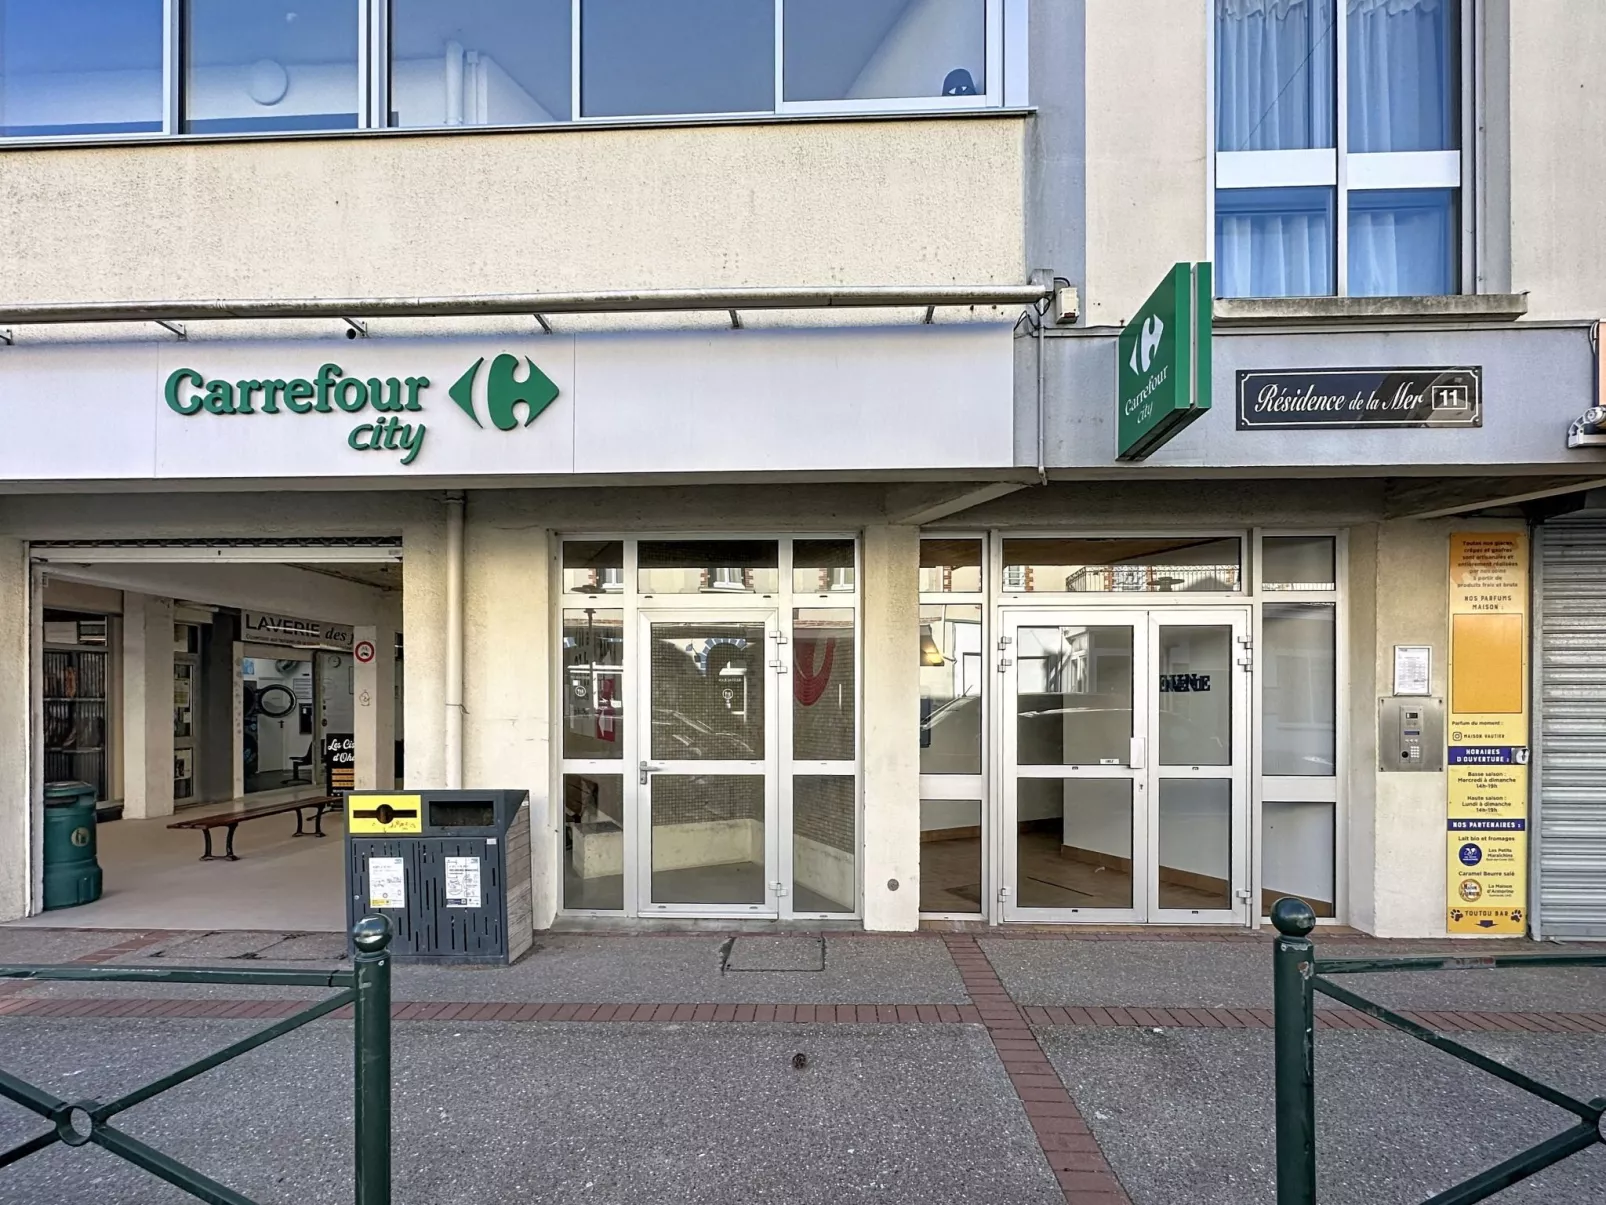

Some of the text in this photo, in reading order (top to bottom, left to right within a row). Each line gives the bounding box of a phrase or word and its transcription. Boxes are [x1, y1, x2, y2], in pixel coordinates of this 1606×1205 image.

[164, 363, 430, 416] Carrefour
[1125, 364, 1169, 416] Carrefour
[1254, 381, 1459, 412] Résidence de la Mer 11
[1137, 400, 1154, 424] city
[347, 416, 427, 466] city
[245, 613, 320, 638] LAVERIE
[325, 627, 346, 642] des
[328, 739, 341, 751] Les
